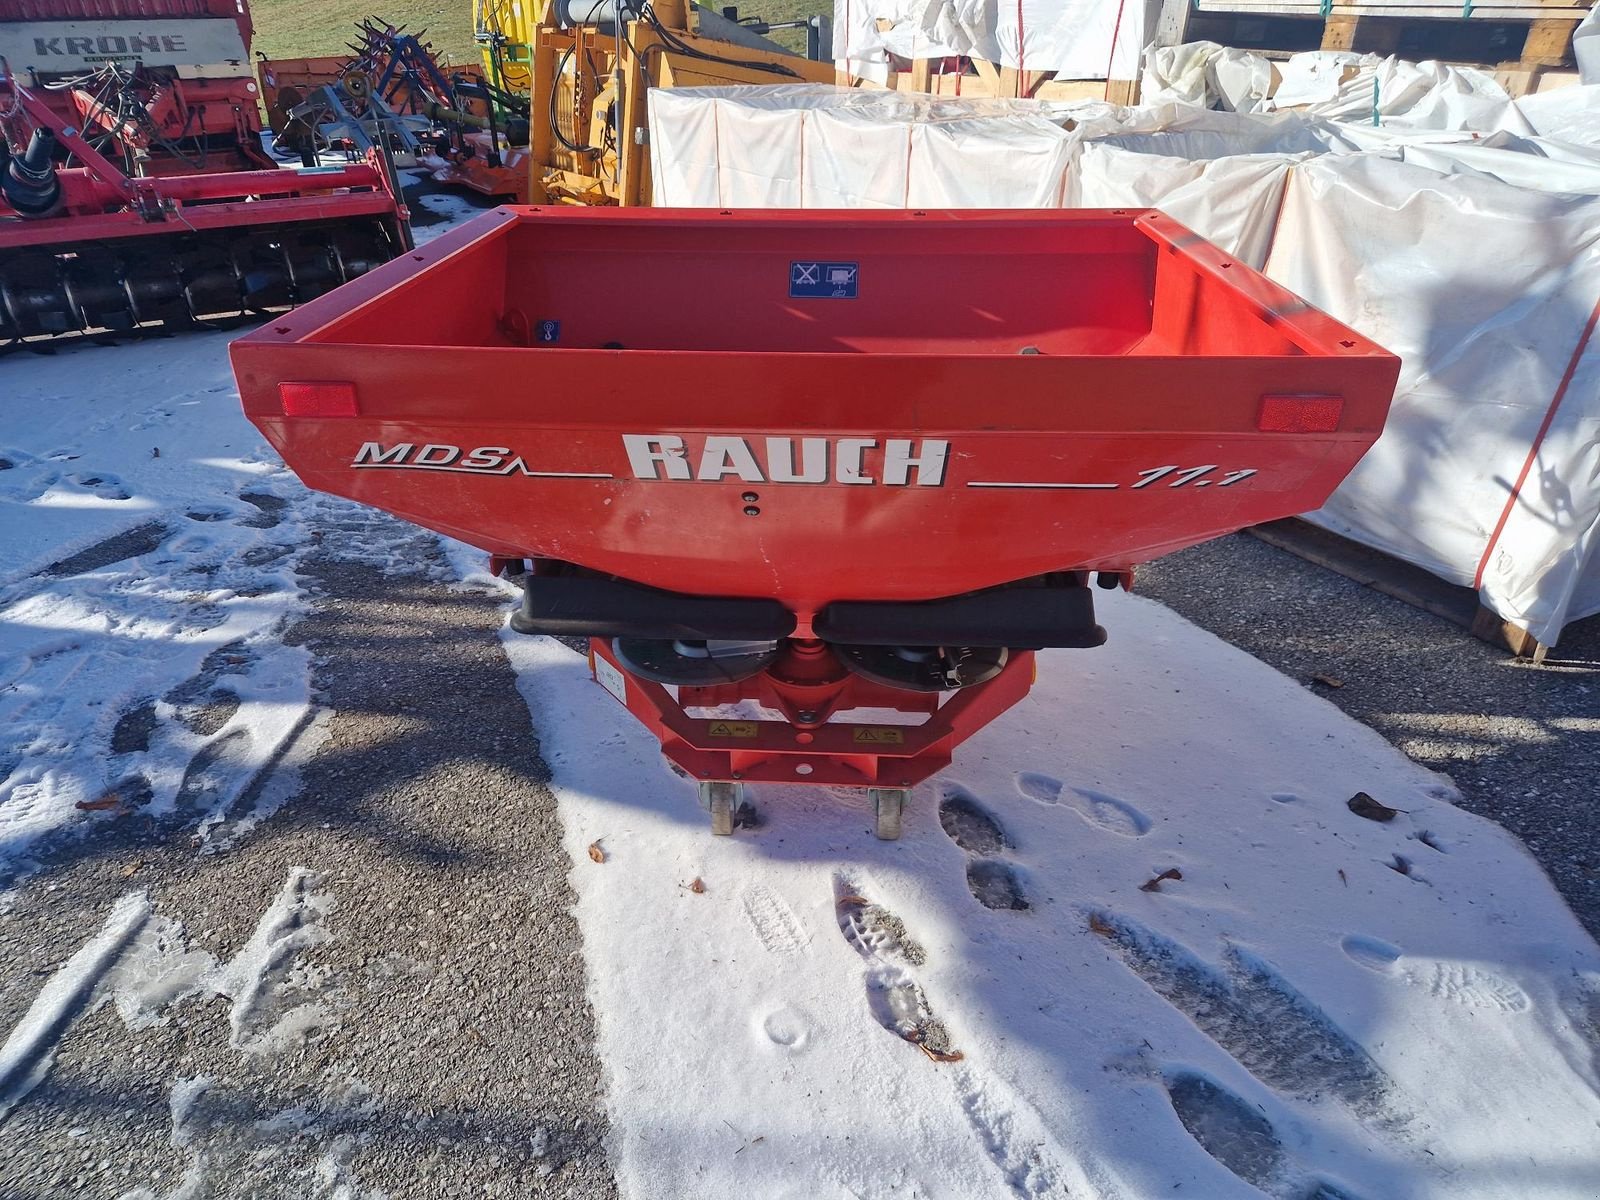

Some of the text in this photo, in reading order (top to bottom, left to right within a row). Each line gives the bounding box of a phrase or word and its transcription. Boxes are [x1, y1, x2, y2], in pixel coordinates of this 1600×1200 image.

[33, 35, 187, 55] KRONE
[353, 442, 511, 469] MDS
[622, 434, 949, 487] RAUCH
[1130, 464, 1259, 488] 11.1
